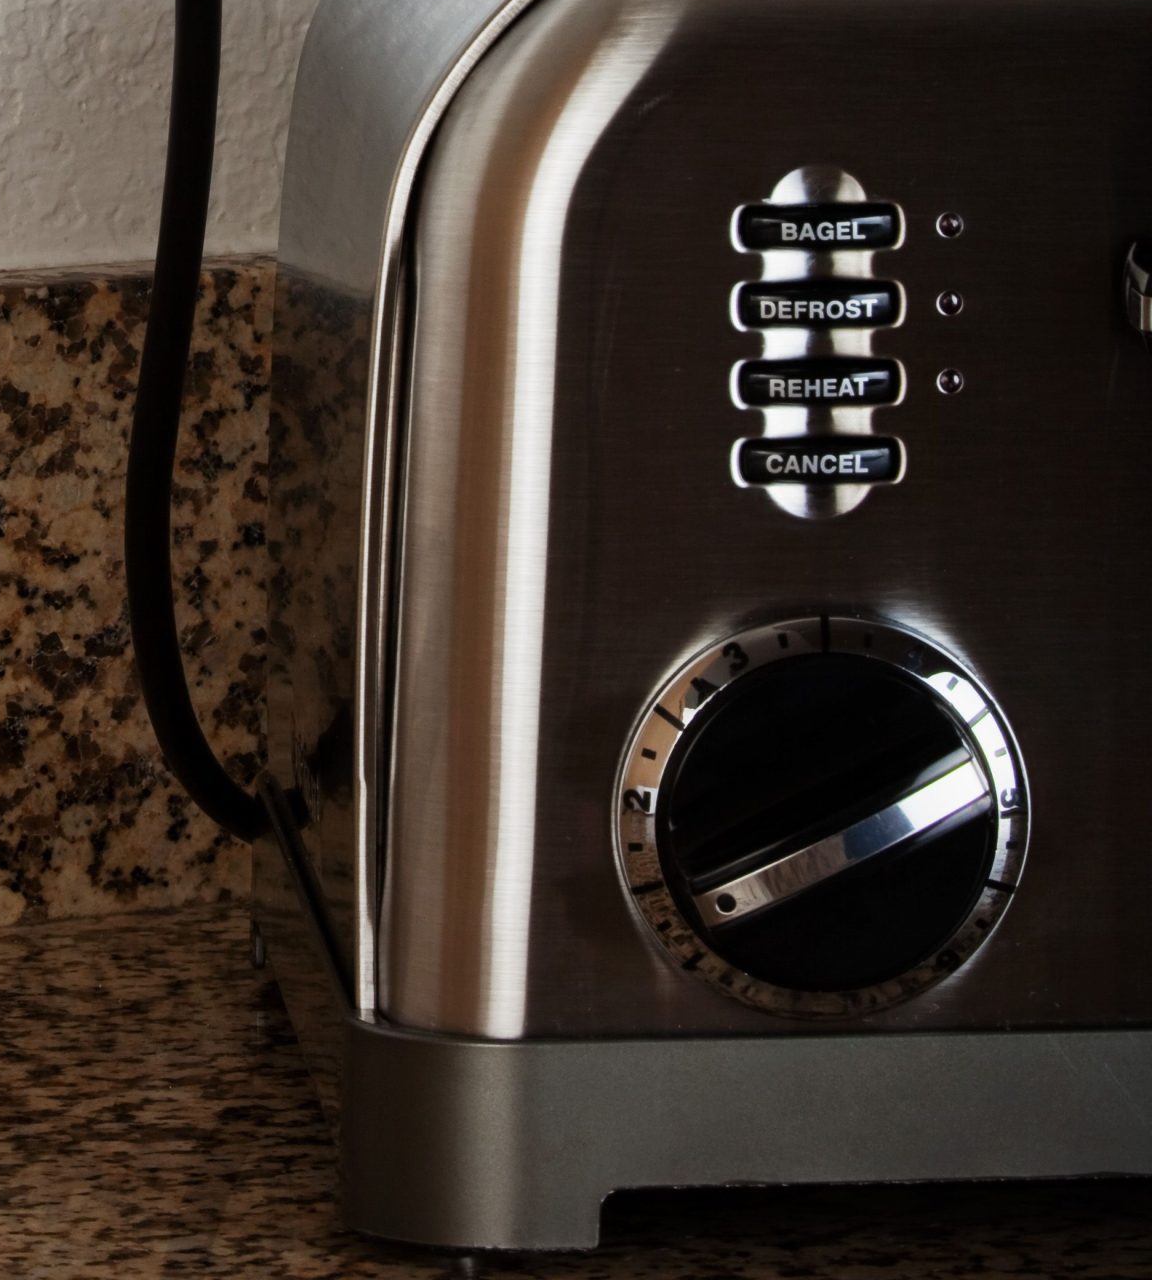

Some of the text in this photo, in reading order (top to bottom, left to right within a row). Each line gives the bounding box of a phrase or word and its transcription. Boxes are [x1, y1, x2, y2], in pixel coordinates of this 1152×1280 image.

[780, 221, 867, 241] BAGEL
[759, 299, 879, 320] DEFROST
[769, 377, 870, 399] REHEAT
[765, 454, 870, 475] CANCEL
[721, 641, 750, 677] 3
[623, 788, 652, 813] 2
